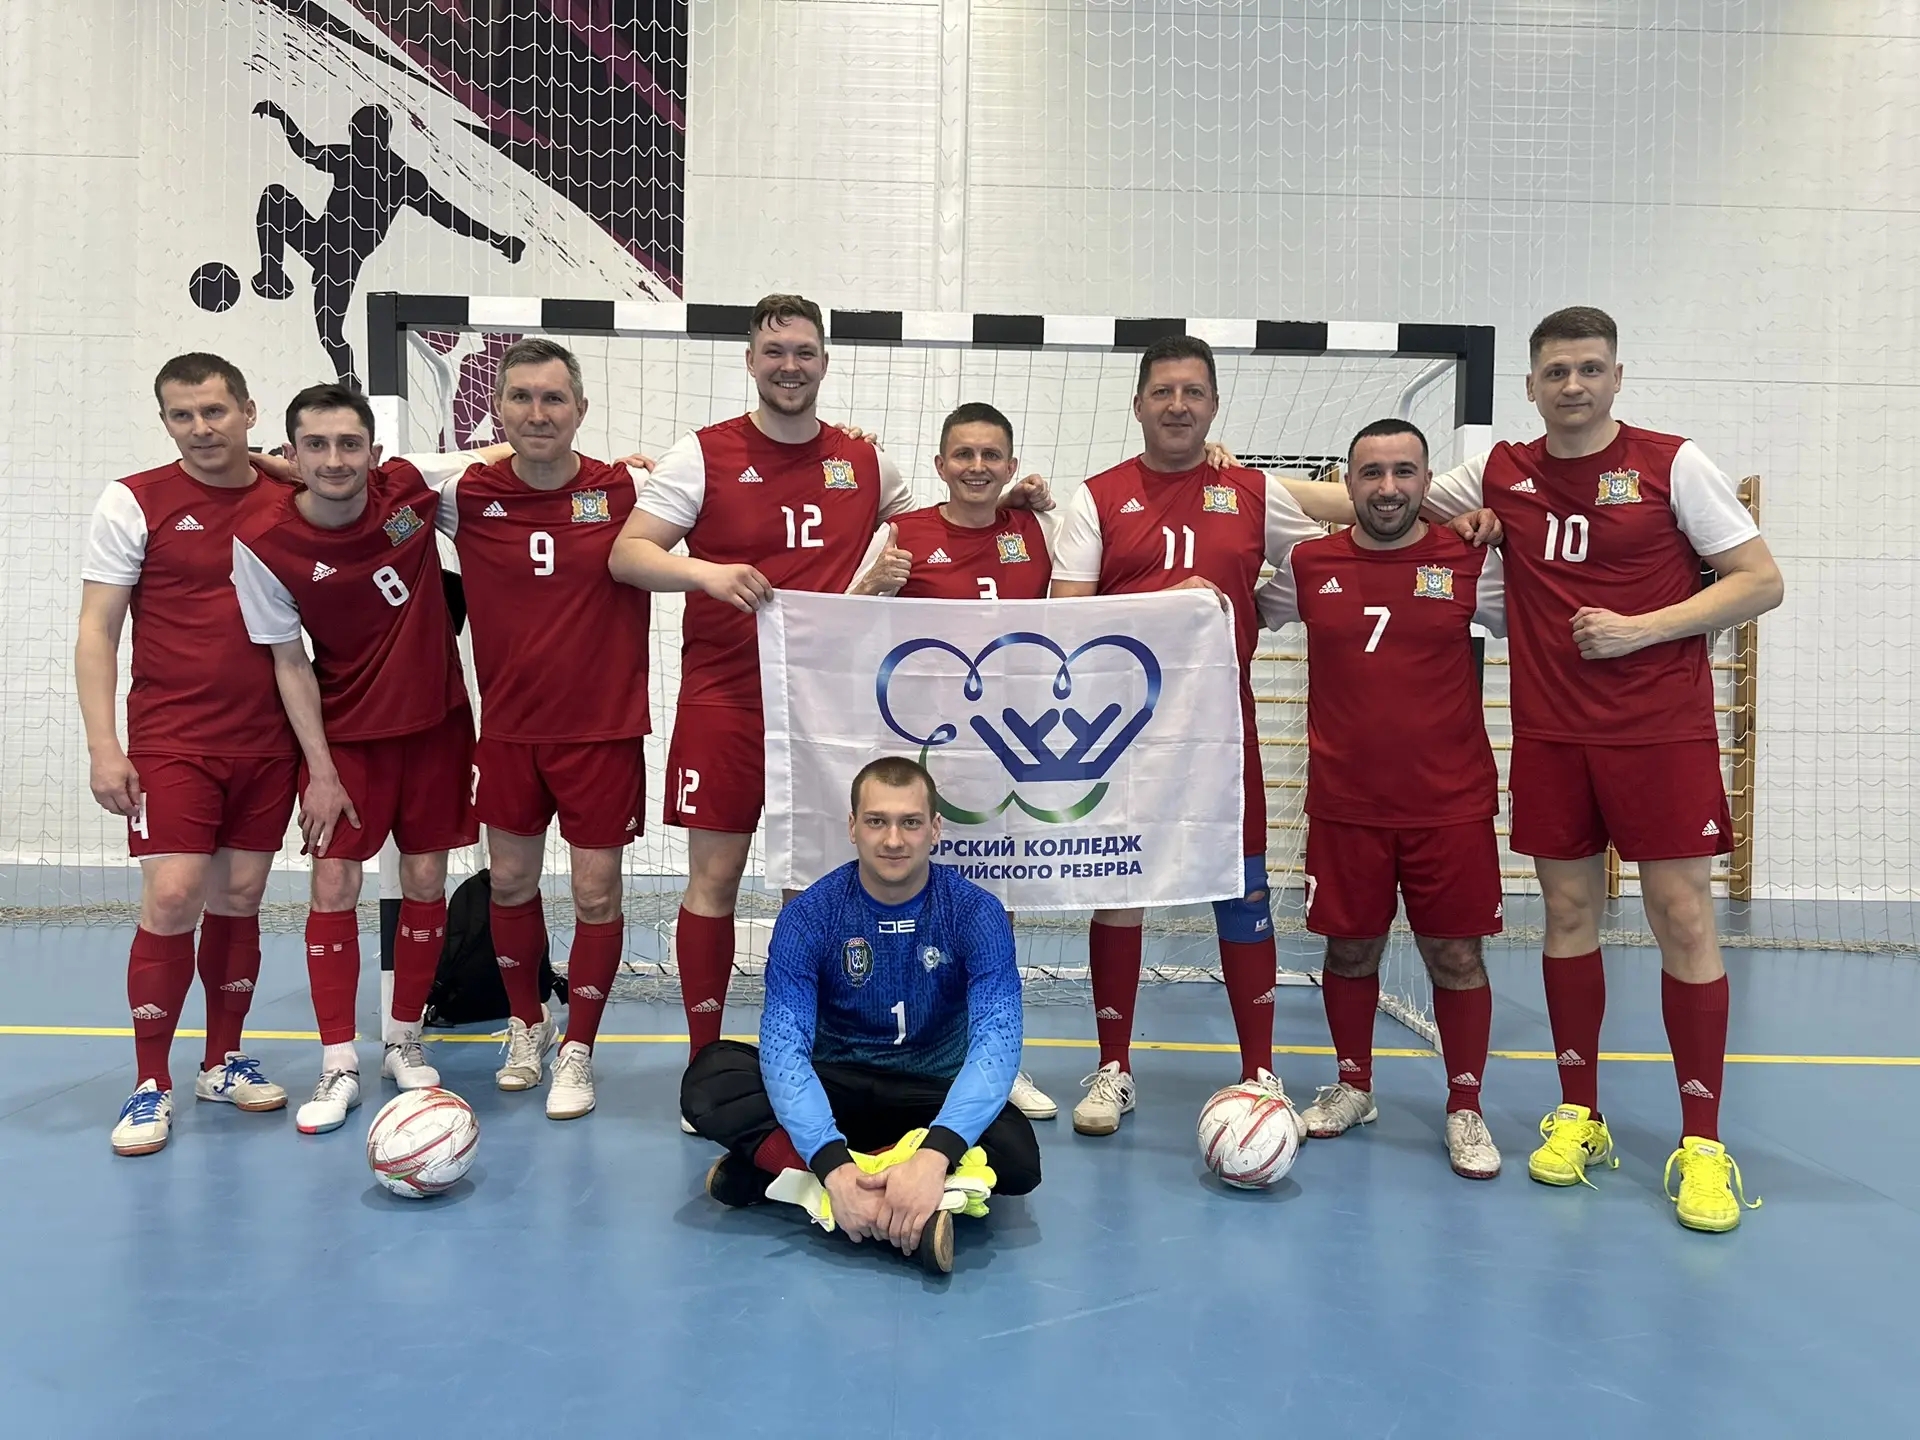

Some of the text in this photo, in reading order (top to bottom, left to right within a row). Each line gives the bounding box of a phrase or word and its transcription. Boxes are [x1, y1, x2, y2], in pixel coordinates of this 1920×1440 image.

[1510, 485, 1537, 494] adidas
[174, 523, 204, 531] adidas
[780, 503, 825, 548] 12
[1544, 512, 1590, 562] 10
[529, 531, 555, 576] 9
[1162, 525, 1195, 570] 11
[311, 566, 337, 582] adidas
[372, 565, 411, 607] 8
[976, 576, 999, 600] 3
[1363, 606, 1392, 653] 7
[676, 767, 700, 815] 12
[130, 792, 149, 840] 4
[929, 834, 1142, 857] ОРСКИЙ КОЛЛЕДЖ
[1060, 860, 1143, 879] РЕЗЕРВА
[890, 1000, 907, 1045] 1
[1452, 1077, 1480, 1086] adidas
[1680, 1085, 1714, 1099] adidas
